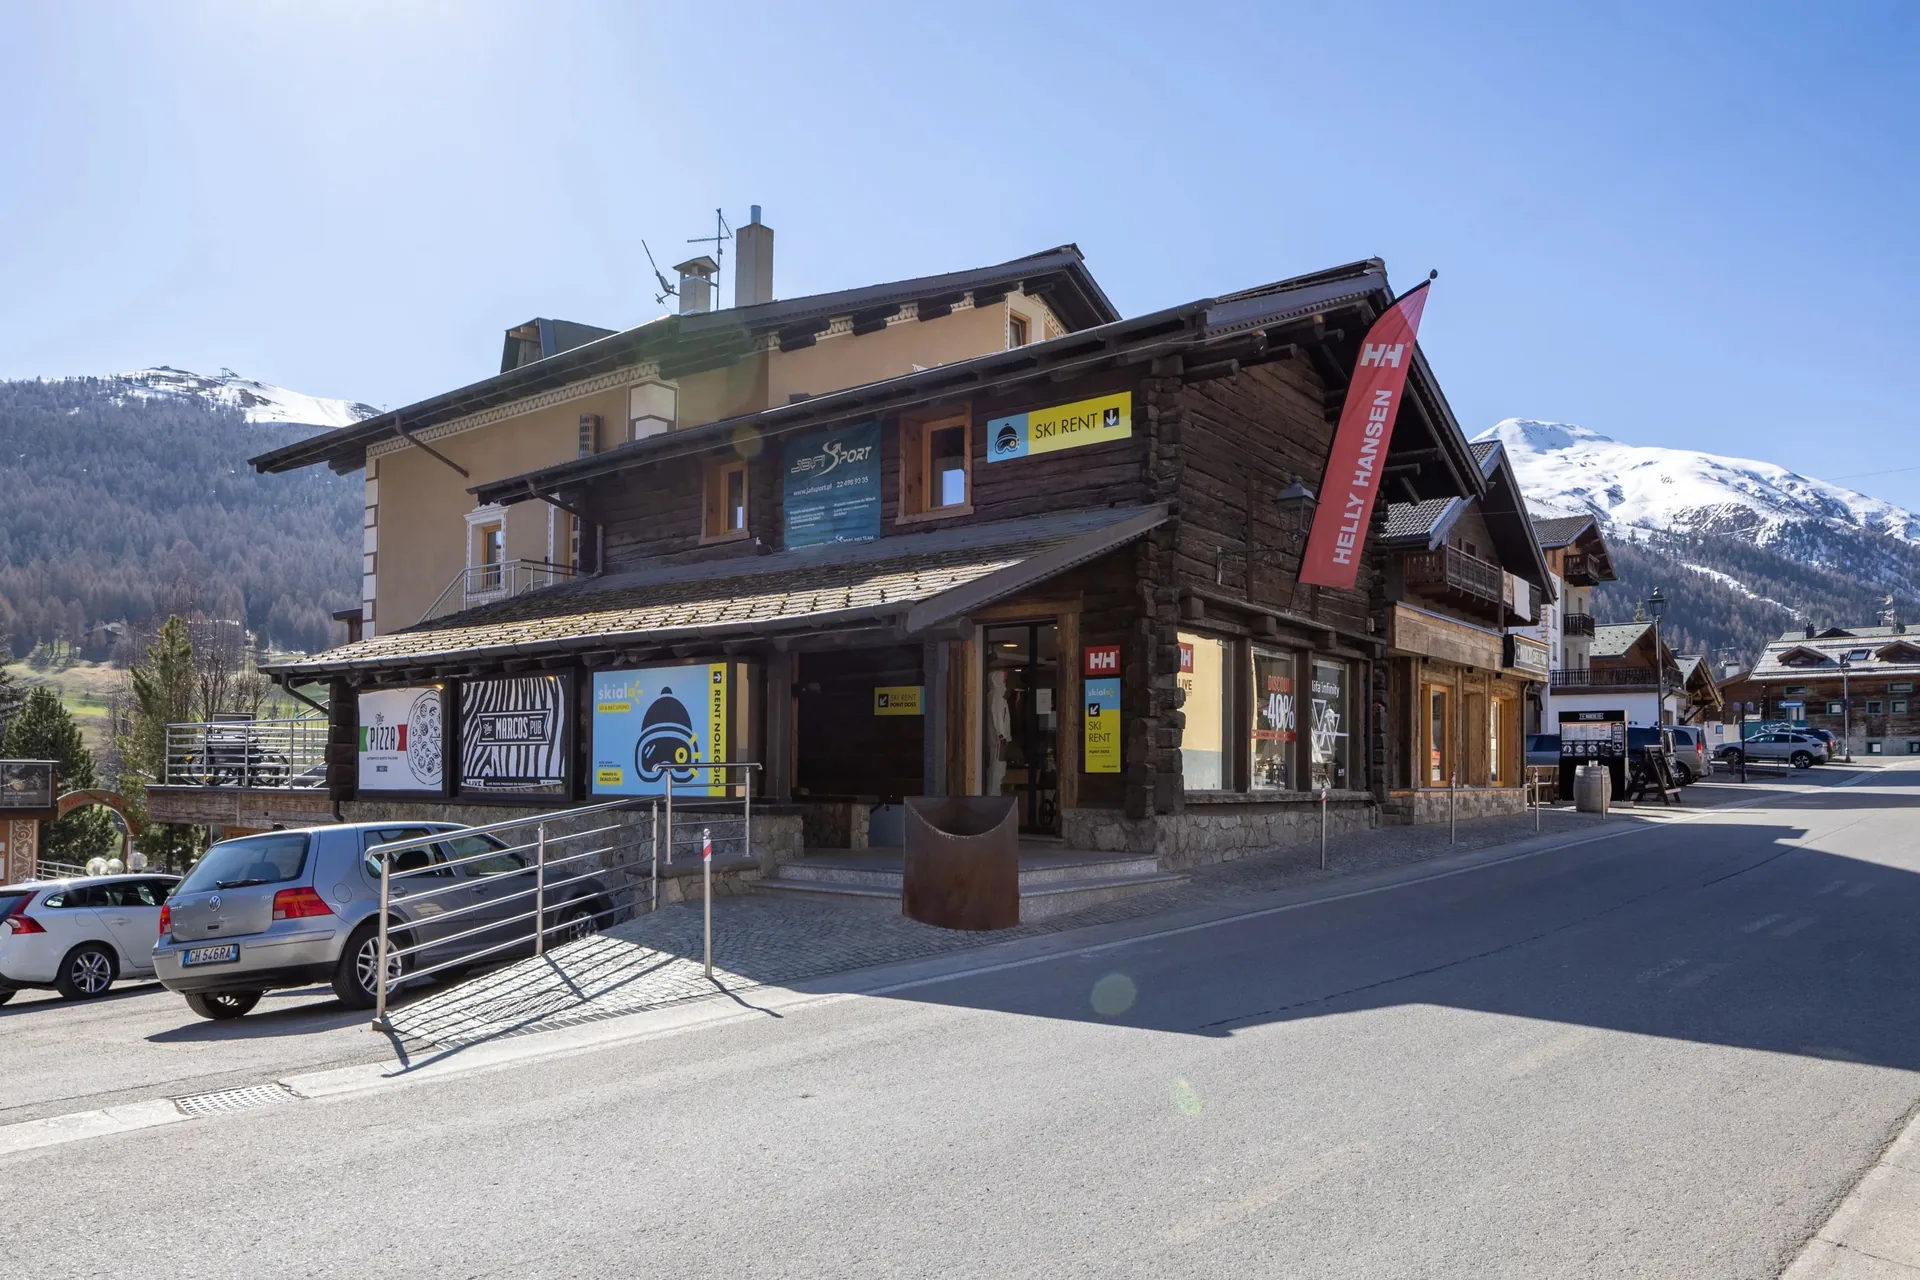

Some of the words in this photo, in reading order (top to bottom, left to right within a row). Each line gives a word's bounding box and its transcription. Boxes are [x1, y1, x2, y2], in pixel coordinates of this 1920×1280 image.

[1360, 343, 1404, 368] HH
[1035, 423, 1056, 440] SKI
[1062, 411, 1098, 436] RENT
[1333, 492, 1365, 565] HELLY
[1352, 389, 1393, 487] HANSEN
[1090, 652, 1116, 669] HH
[598, 682, 635, 700] skialo
[1088, 688, 1110, 697] skialo
[1322, 682, 1340, 698] infinity
[1262, 693, 1294, 729] -40%
[496, 717, 528, 739] MARCOS
[530, 720, 542, 735] PUB
[1088, 722, 1101, 731] SKI
[370, 726, 395, 750] PIZZA
[1088, 733, 1112, 742] RENT
[189, 950, 201, 962] CH
[202, 946, 230, 961] 546RA
